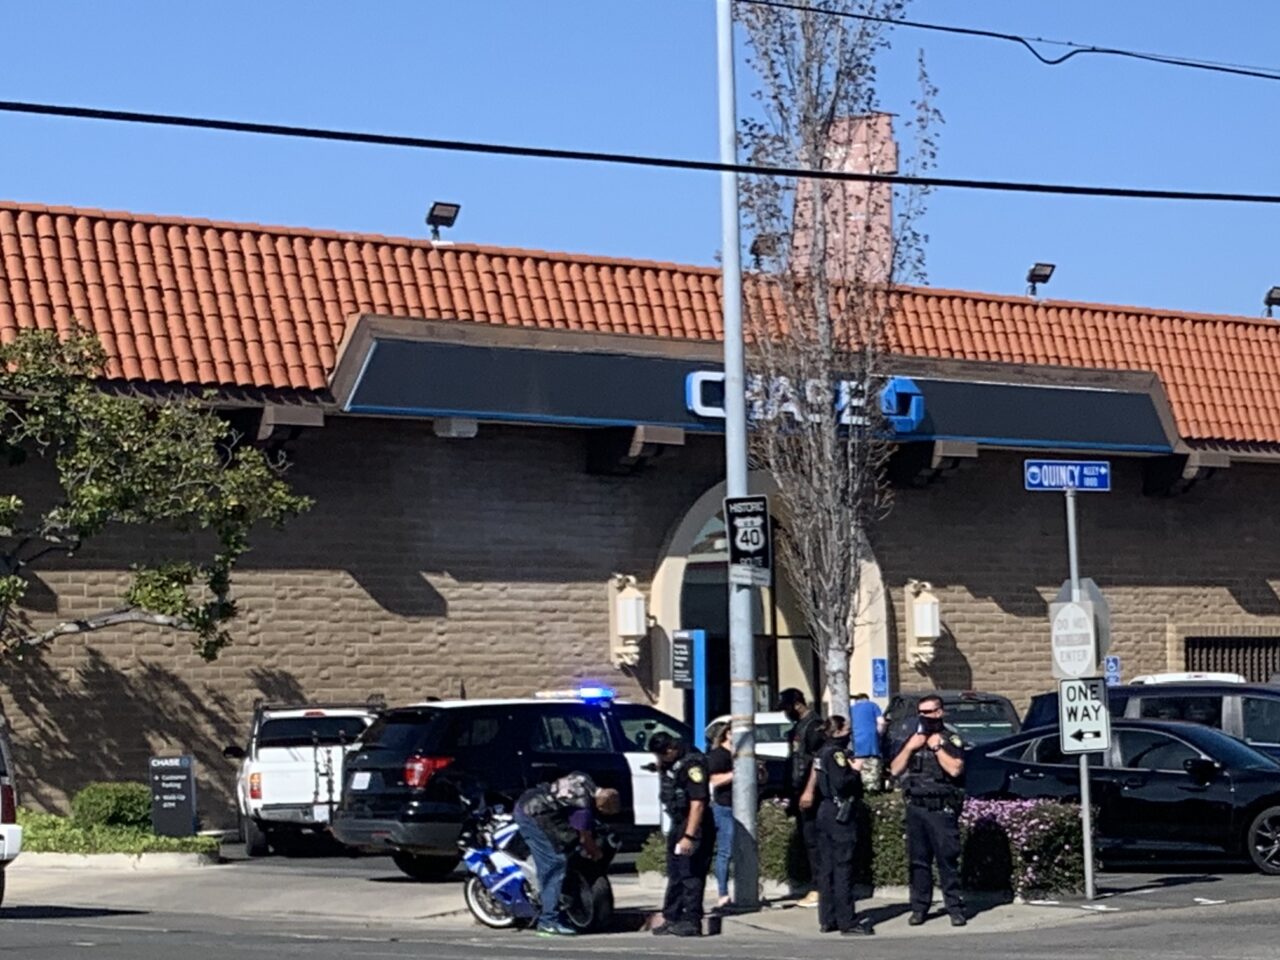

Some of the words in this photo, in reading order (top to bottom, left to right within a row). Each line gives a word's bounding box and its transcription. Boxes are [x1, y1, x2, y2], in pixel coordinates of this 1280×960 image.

[1042, 464, 1080, 487] QUINCY
[729, 501, 765, 514] HISTORIC
[740, 529, 760, 546] 40
[1057, 619, 1069, 631] DO
[1073, 617, 1087, 630] NOT
[1060, 650, 1088, 663] ENTER
[1066, 684, 1100, 702] ONE
[1066, 705, 1102, 723] WAY
[151, 758, 180, 767] CHASE
